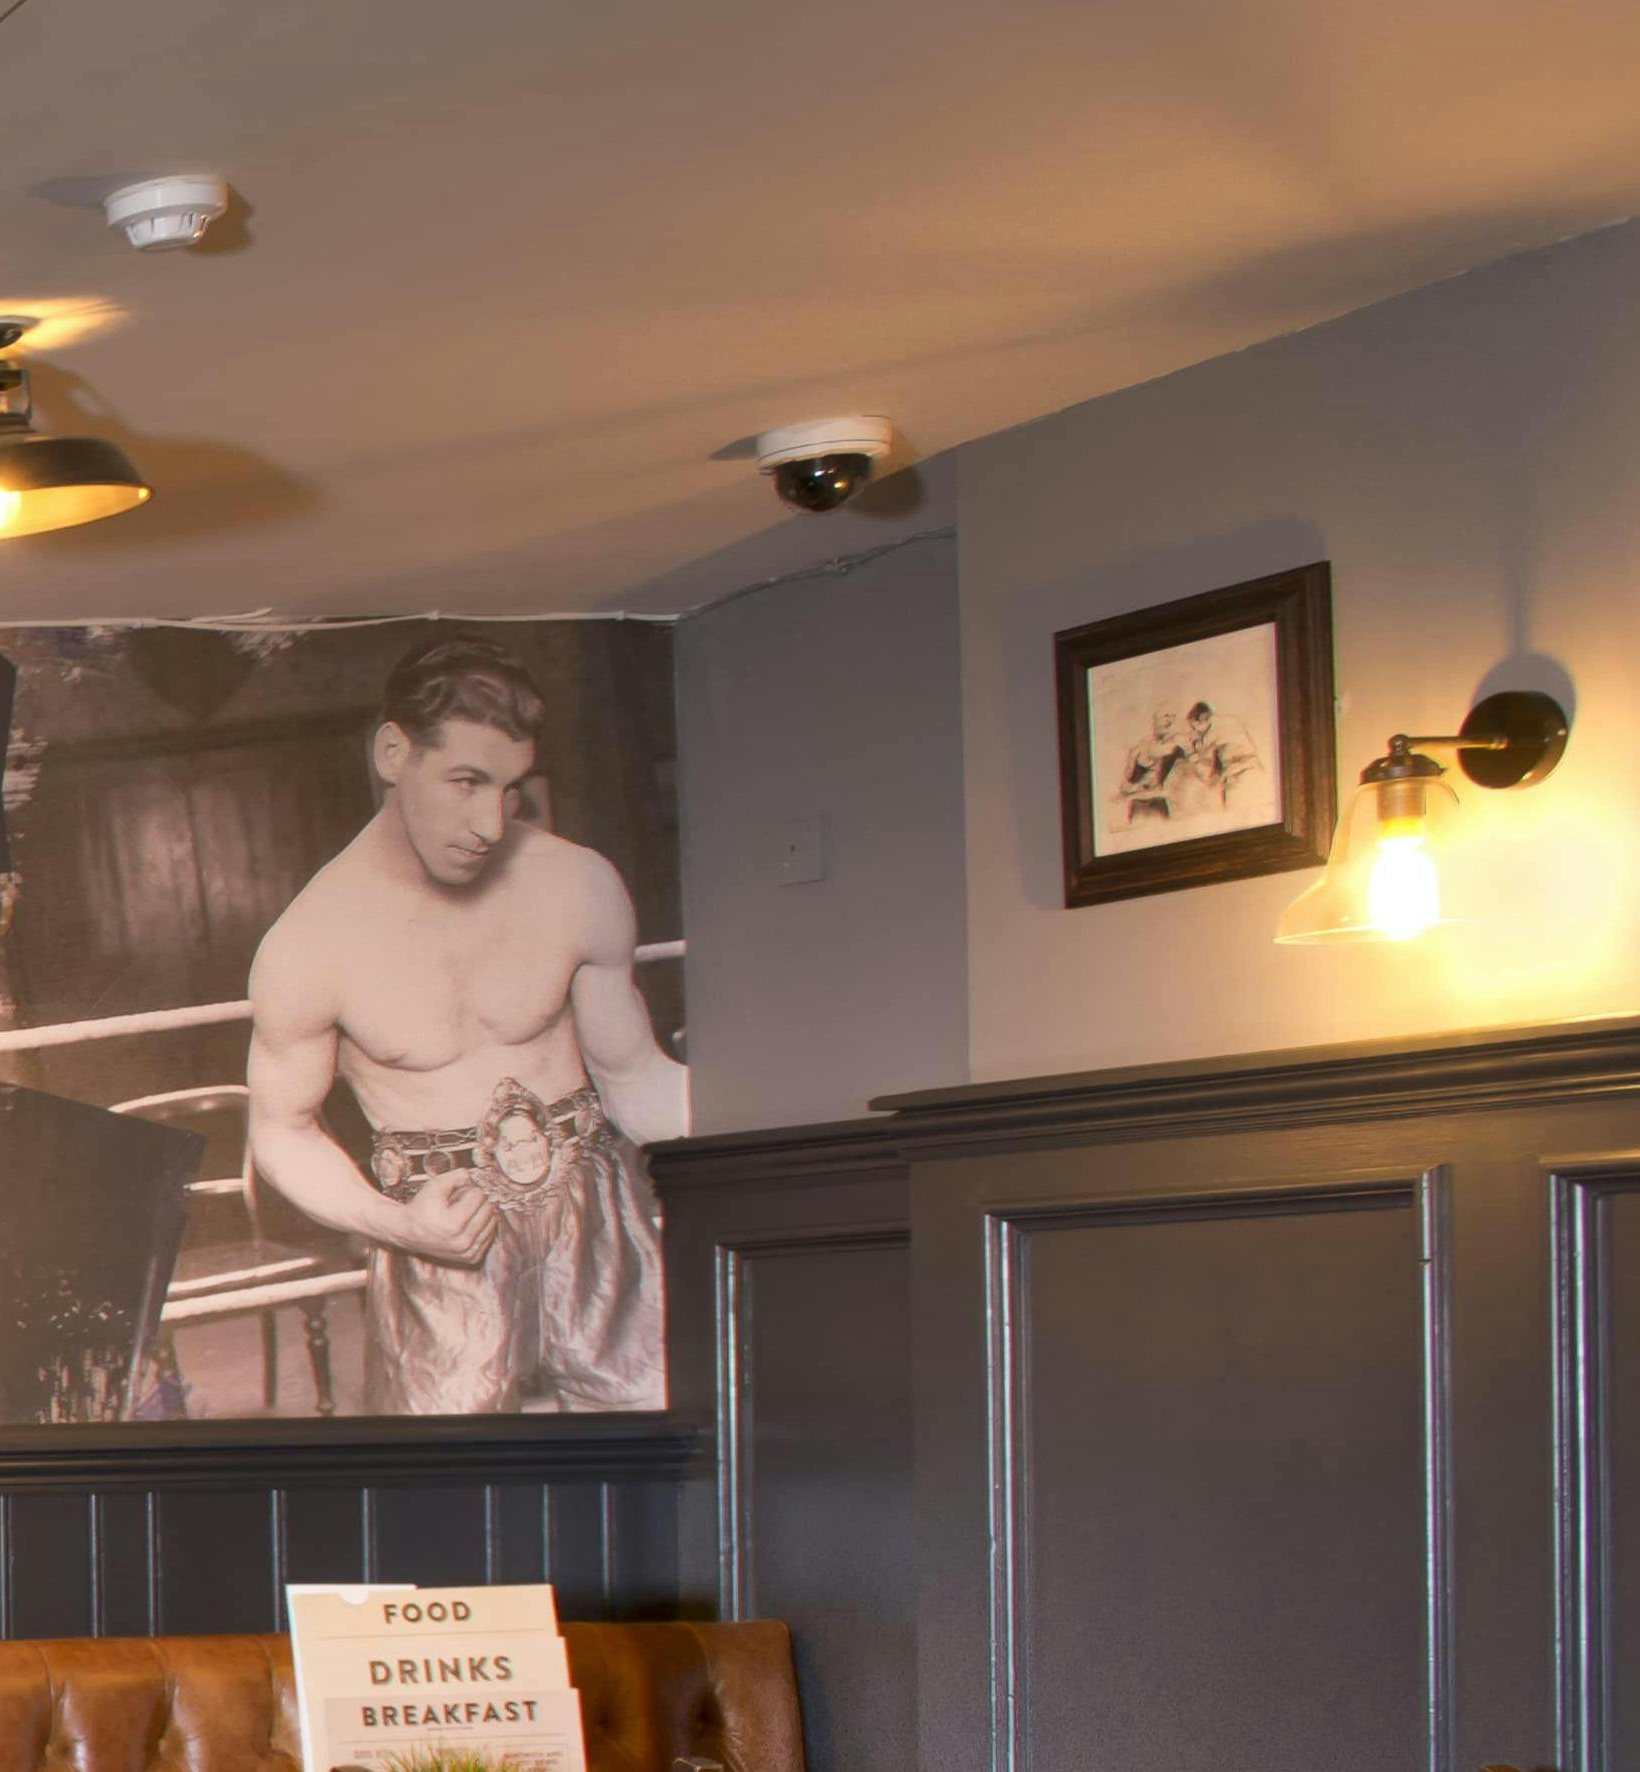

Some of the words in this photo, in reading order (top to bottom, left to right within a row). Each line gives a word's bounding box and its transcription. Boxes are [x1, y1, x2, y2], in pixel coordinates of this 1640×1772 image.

[383, 1600, 471, 1625] FOOD
[369, 1655, 512, 1686] DRINKS
[362, 1700, 538, 1727] BREAKFAST
